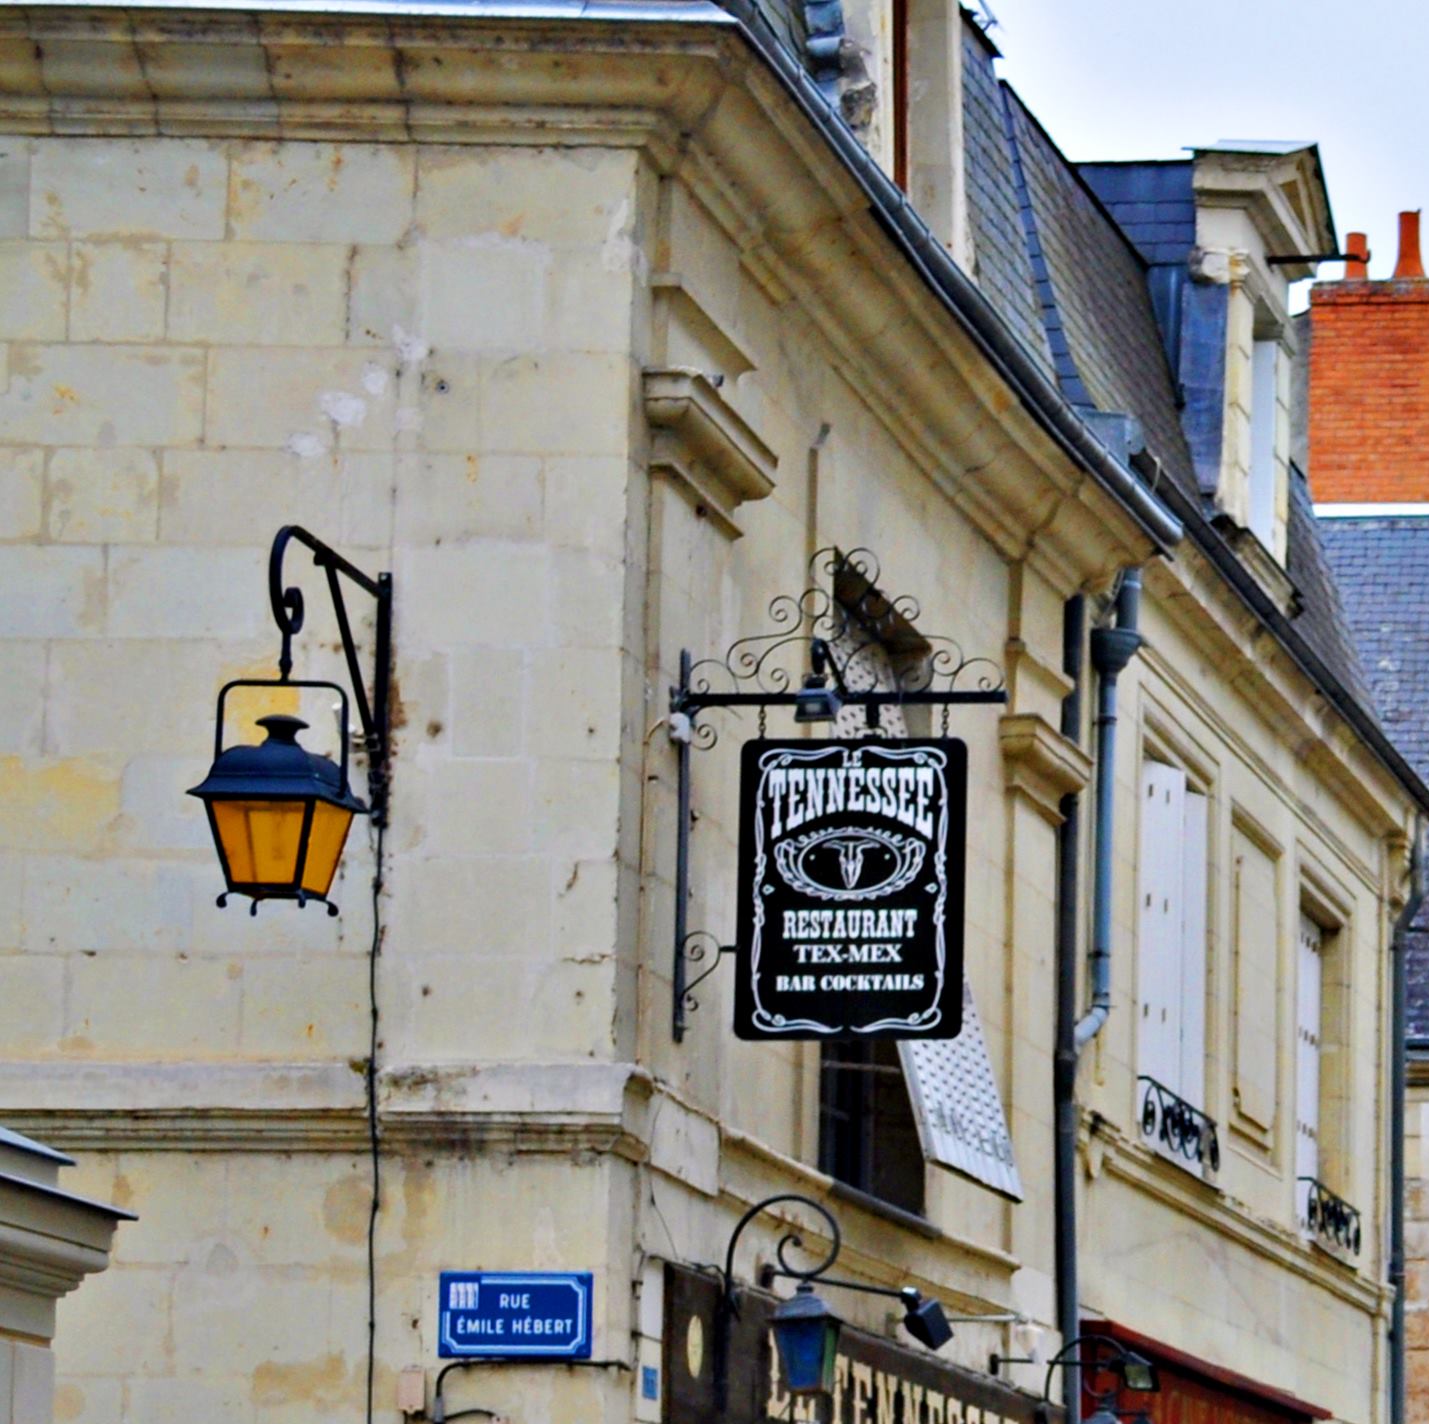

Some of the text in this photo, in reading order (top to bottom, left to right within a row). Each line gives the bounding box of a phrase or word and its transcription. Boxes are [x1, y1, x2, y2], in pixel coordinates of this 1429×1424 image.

[843, 751, 862, 768] LE
[768, 766, 935, 840] TENNESSEE
[783, 909, 917, 939] RESTAURANT
[793, 944, 902, 964] TEX-MEX
[776, 974, 924, 992] BAR COCKTAILS
[499, 1293, 530, 1310] RUE
[456, 1316, 573, 1335] ÉMILE HÉBERT
